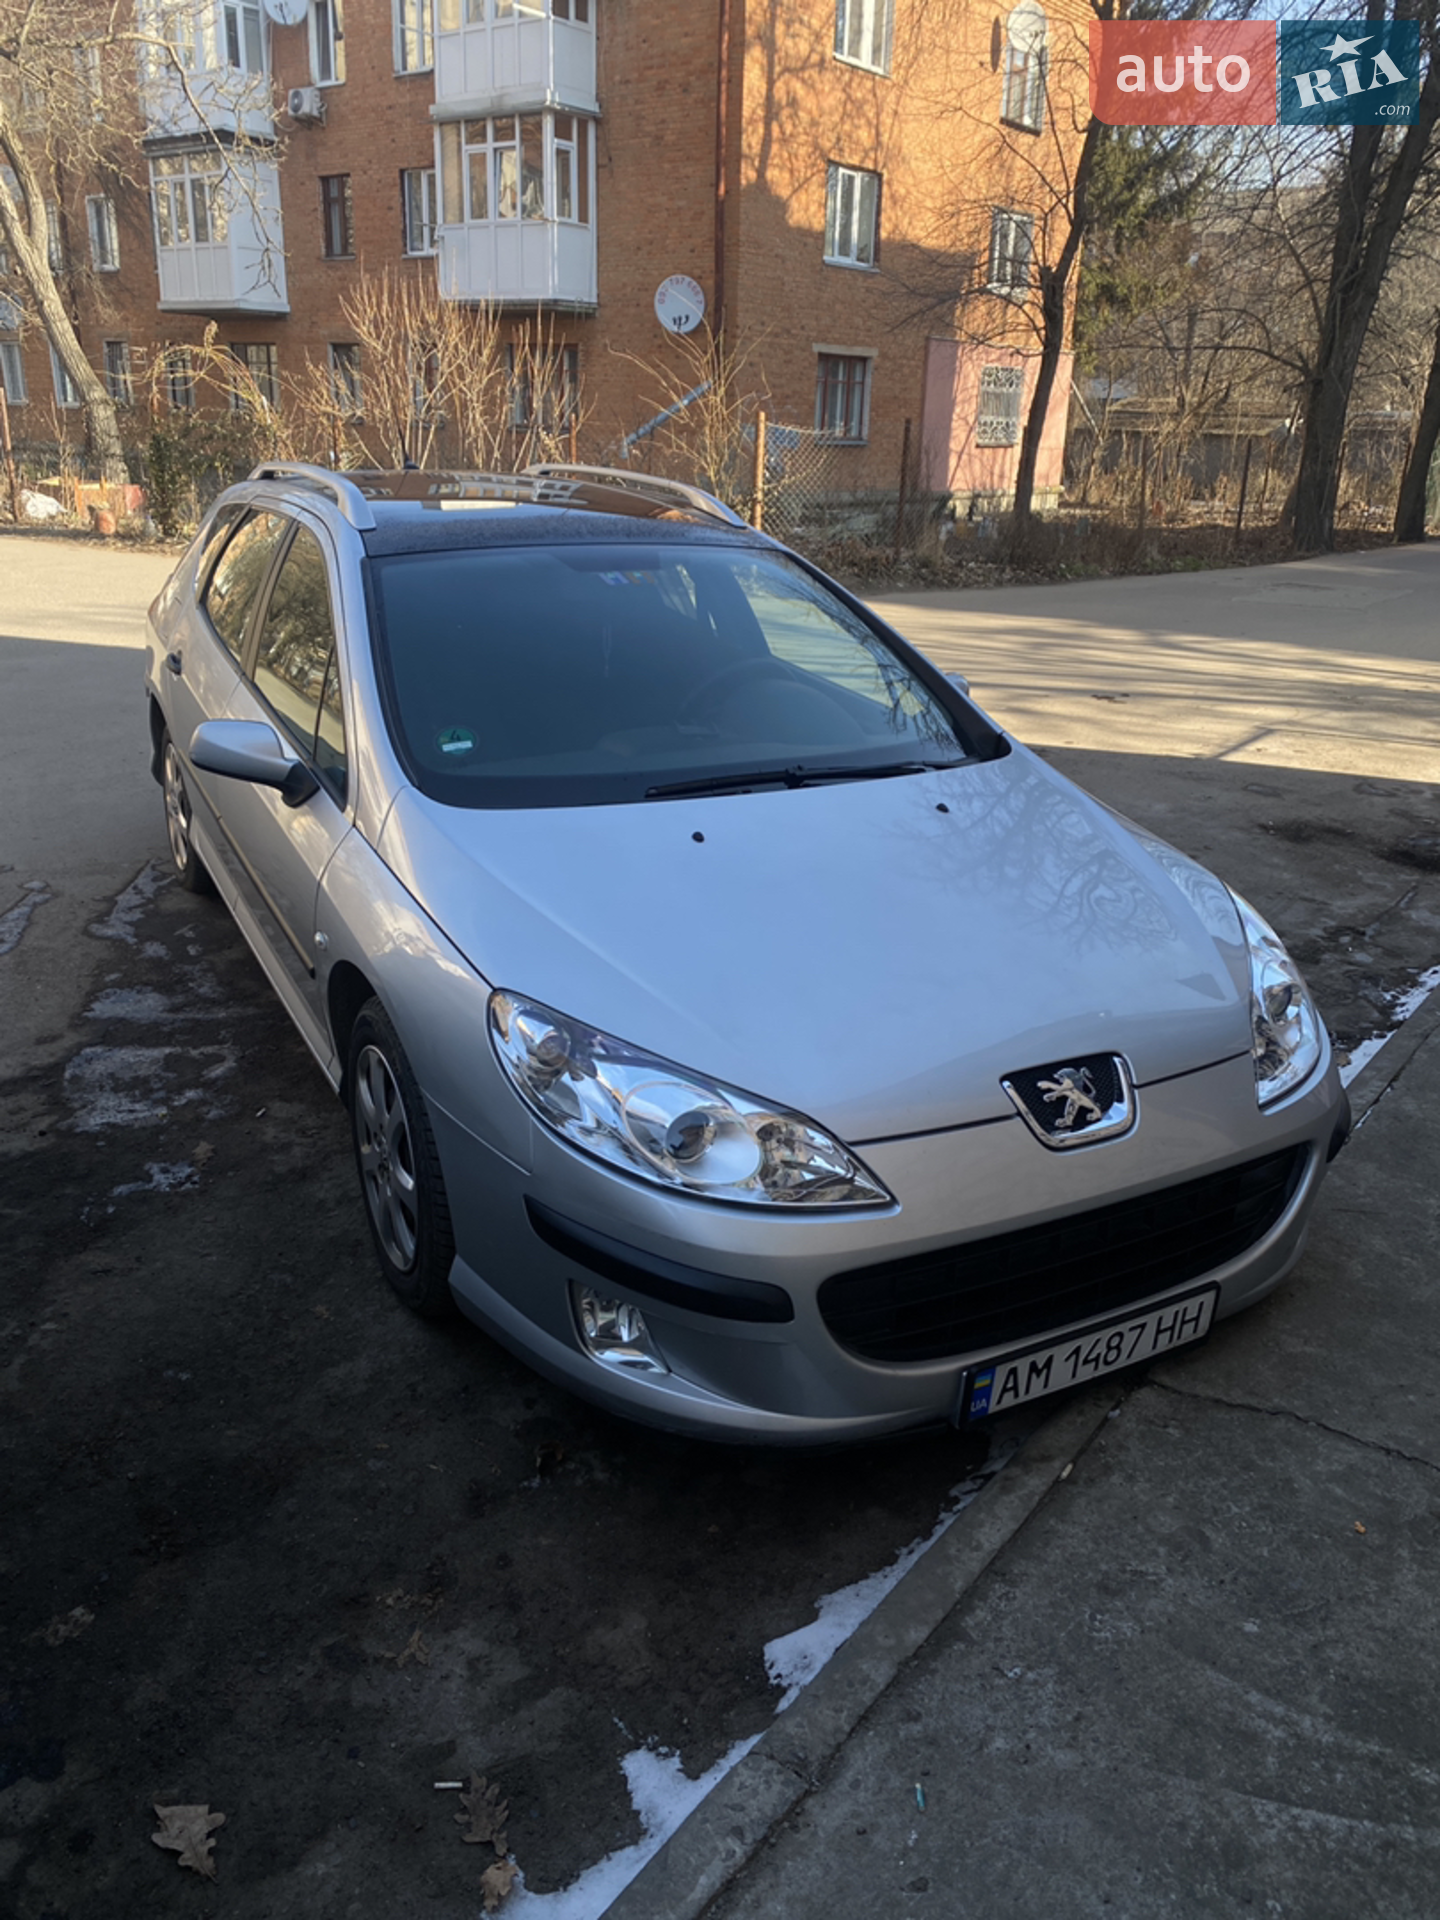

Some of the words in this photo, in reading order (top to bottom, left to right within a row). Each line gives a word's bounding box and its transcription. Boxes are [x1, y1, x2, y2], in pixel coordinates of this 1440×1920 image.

[995, 1353, 1055, 1406] AM
[1064, 1322, 1148, 1380] 1487
[1152, 1300, 1205, 1350] HH
[970, 1398, 988, 1413] UA
